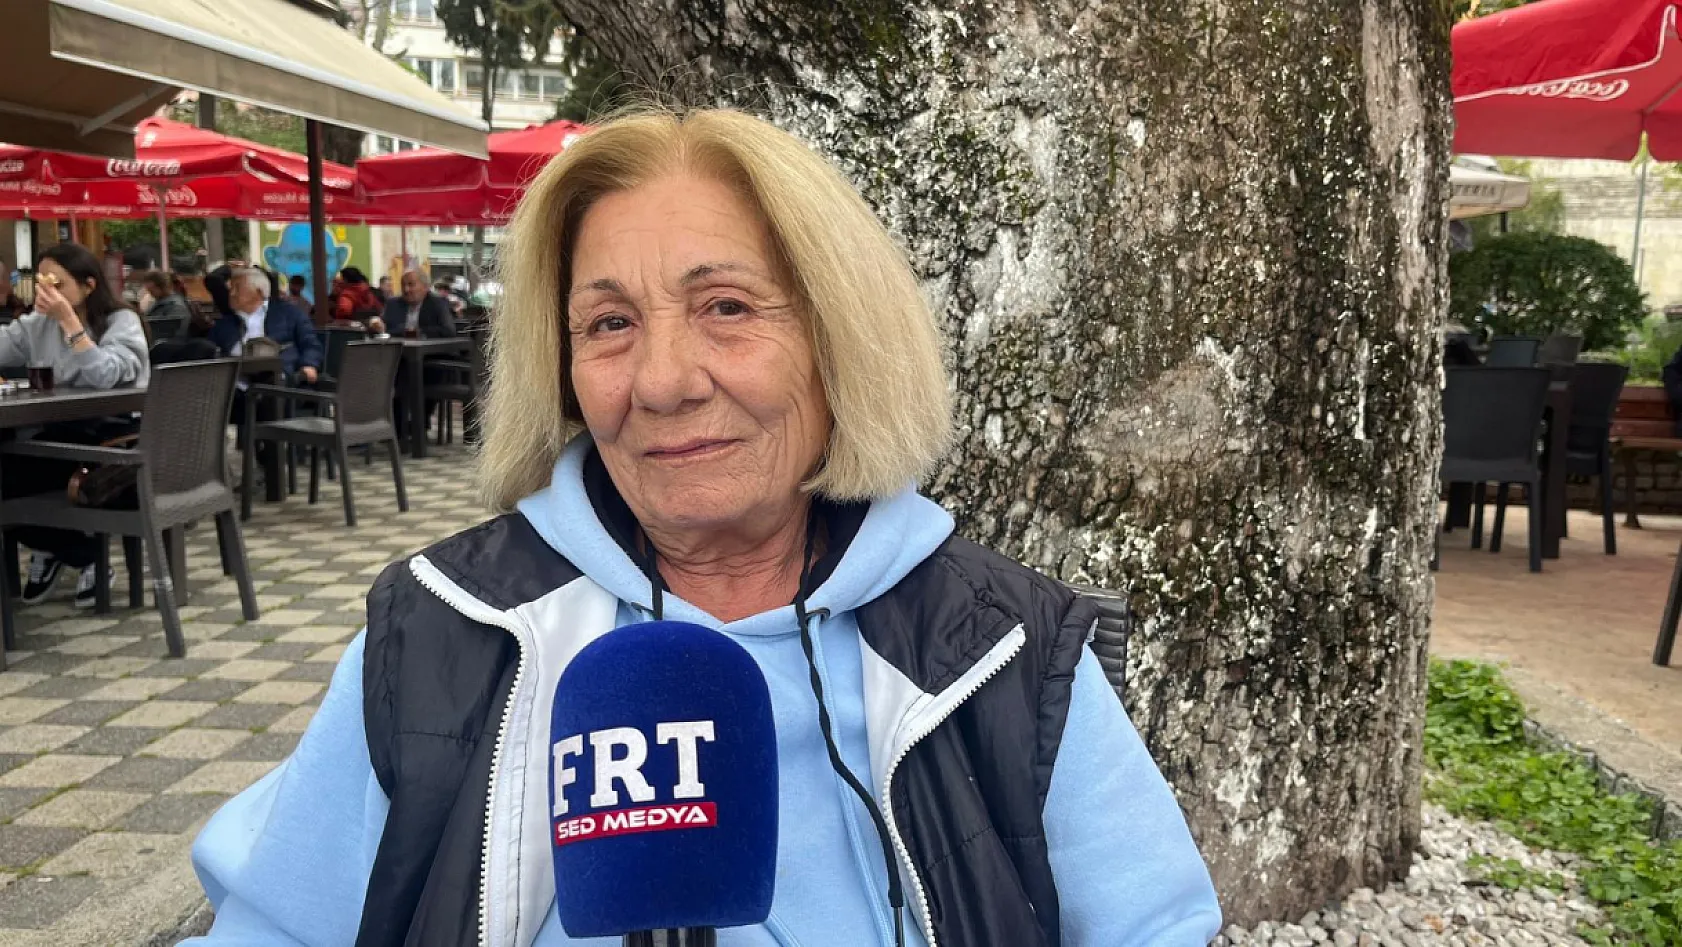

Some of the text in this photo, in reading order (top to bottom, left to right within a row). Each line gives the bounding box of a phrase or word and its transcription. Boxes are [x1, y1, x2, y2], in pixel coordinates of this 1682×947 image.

[553, 720, 715, 817] FRT
[557, 805, 709, 839] SED MEDYA
